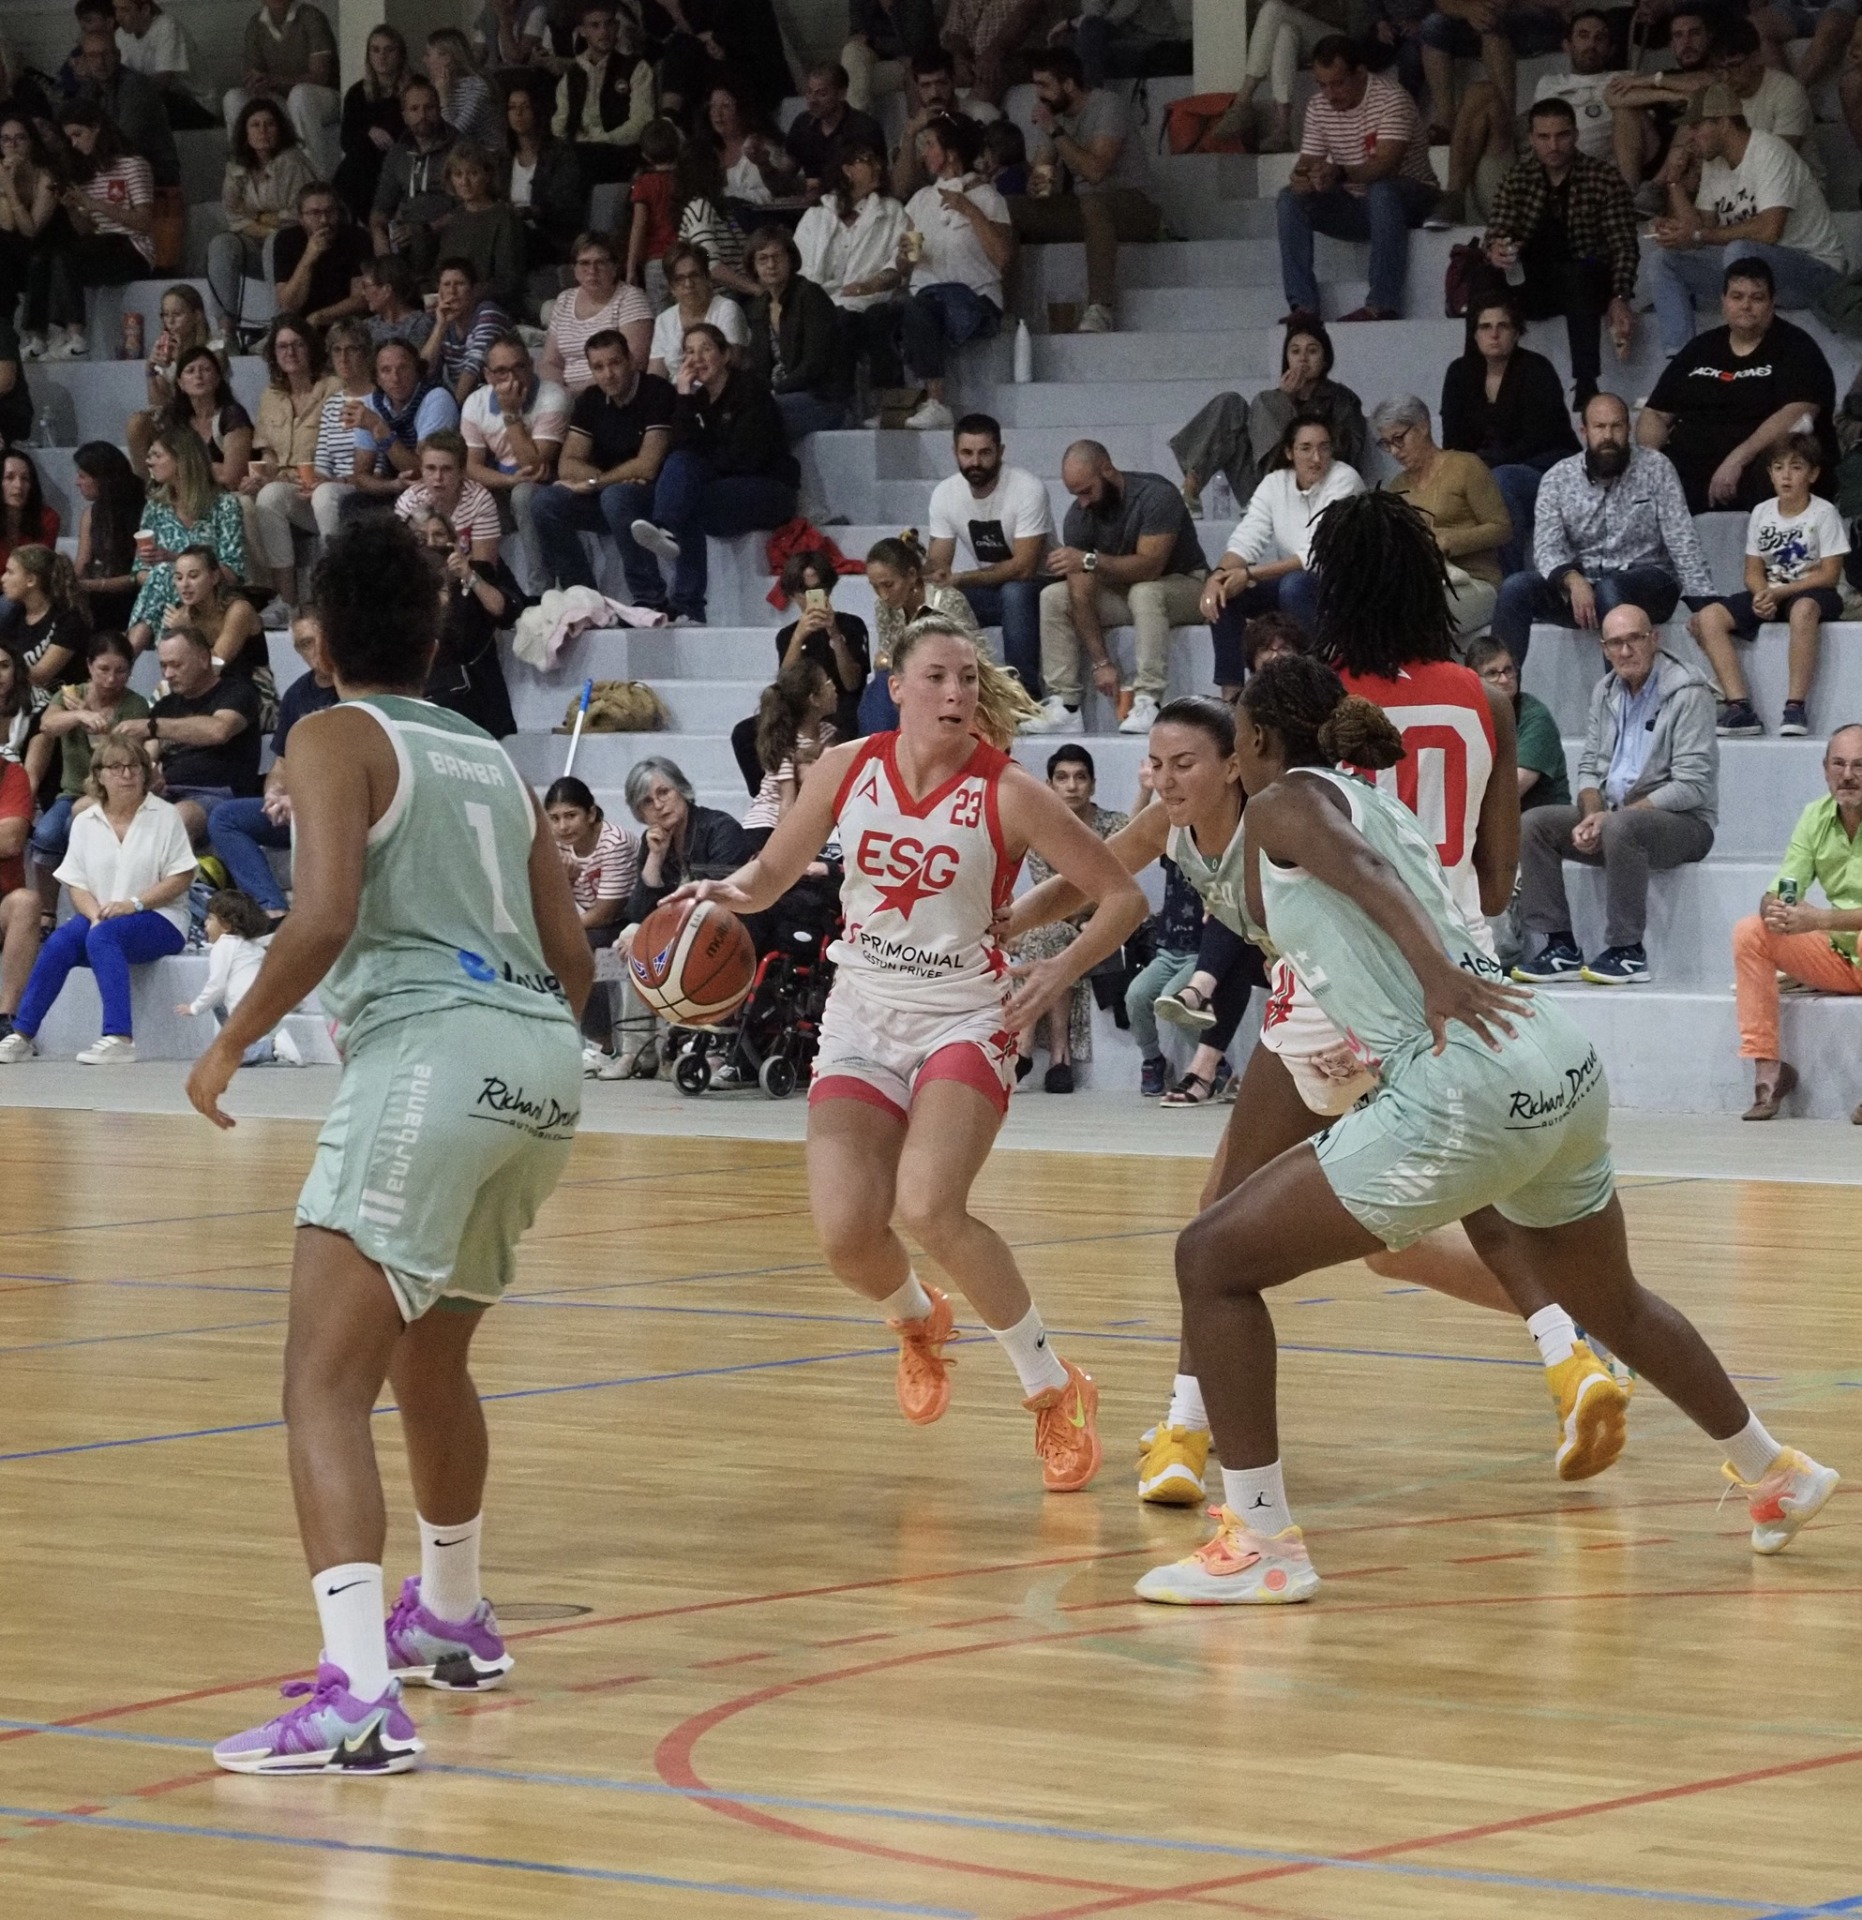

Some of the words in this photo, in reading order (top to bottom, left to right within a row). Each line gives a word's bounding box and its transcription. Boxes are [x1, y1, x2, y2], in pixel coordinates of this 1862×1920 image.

[950, 788, 983, 829] 23
[464, 801, 519, 934] 1
[857, 829, 960, 889] ESG
[860, 932, 964, 968] PRIMONIAL
